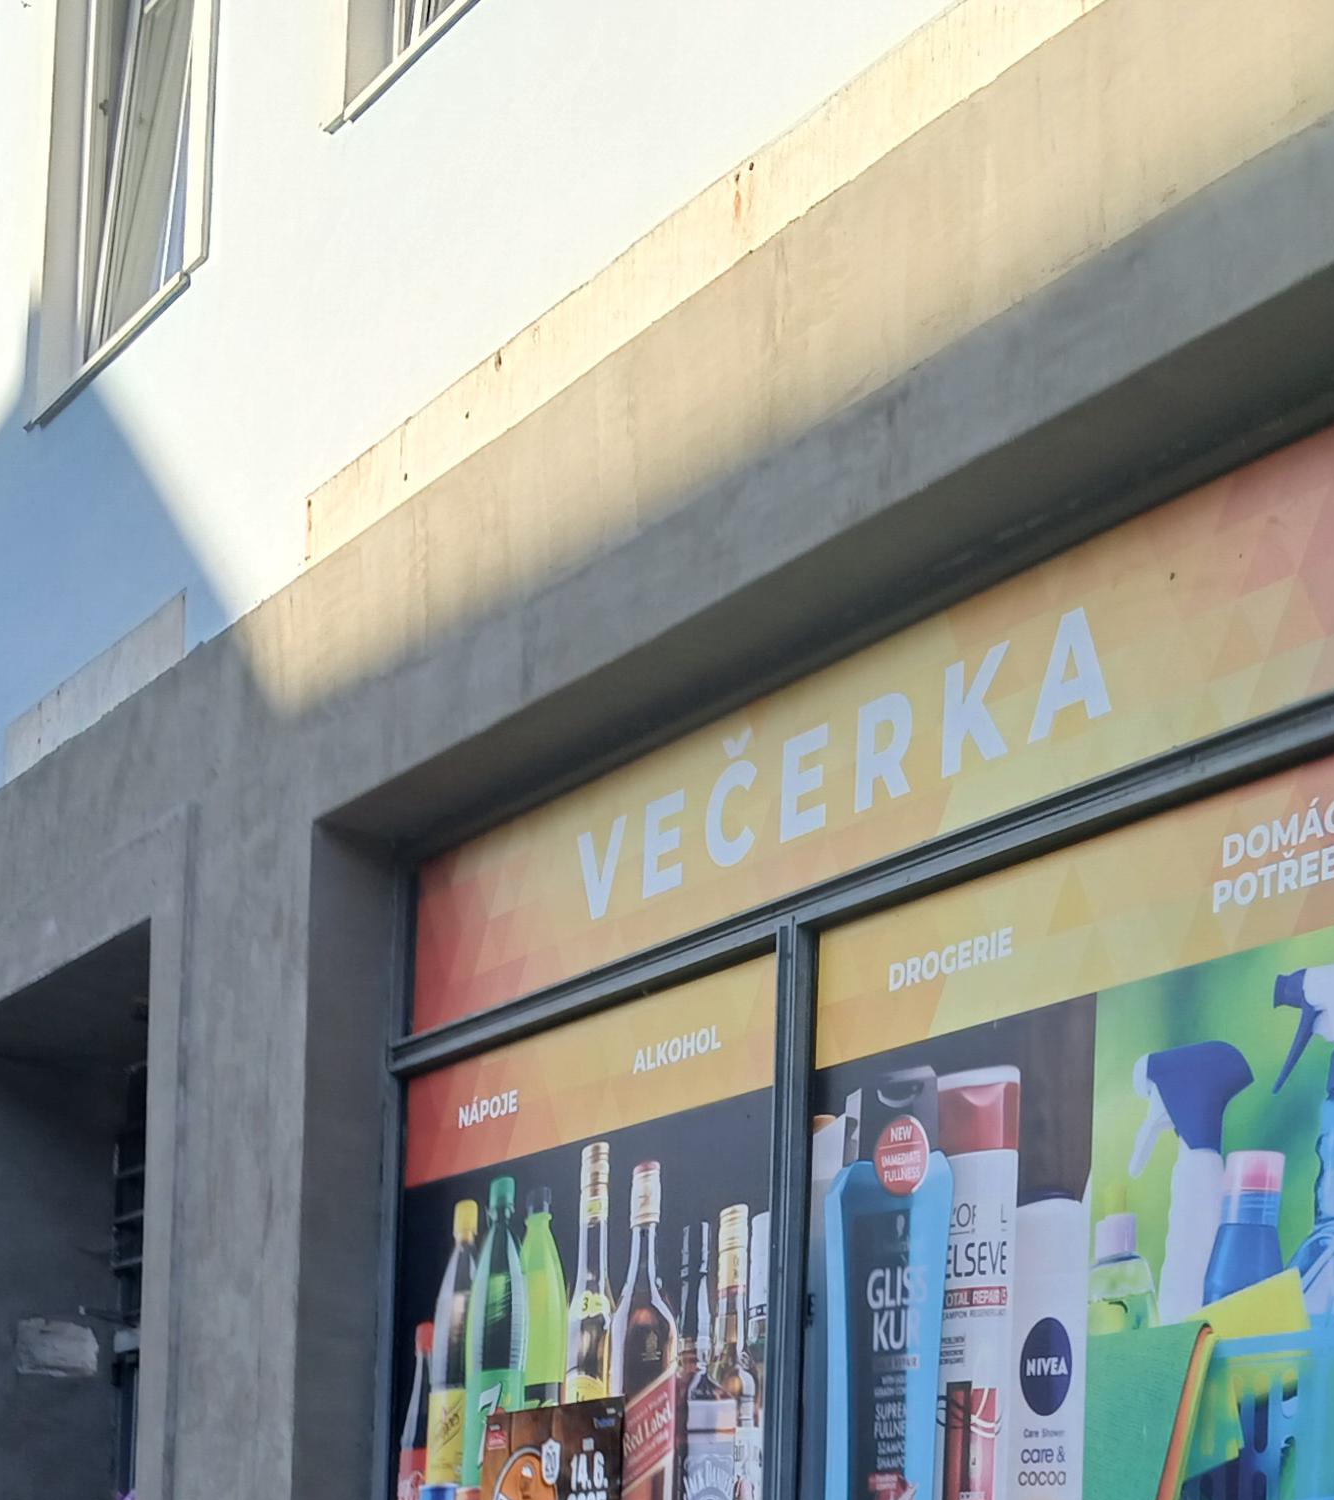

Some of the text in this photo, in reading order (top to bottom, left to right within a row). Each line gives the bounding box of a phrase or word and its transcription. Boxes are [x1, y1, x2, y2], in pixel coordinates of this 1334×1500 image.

[576, 605, 1113, 921] VEČERKA
[888, 926, 1014, 992] DROGERIE
[632, 1025, 722, 1074] ALKOHOL
[458, 1089, 518, 1128] NÁPOJE
[890, 1125, 913, 1142] NEW
[943, 1291, 970, 1308] OTAL
[1025, 1356, 1069, 1377] NIVEA
[570, 1450, 609, 1491] 14. 6.
[1020, 1446, 1067, 1465] care &
[1017, 1470, 1067, 1487] cocoa
